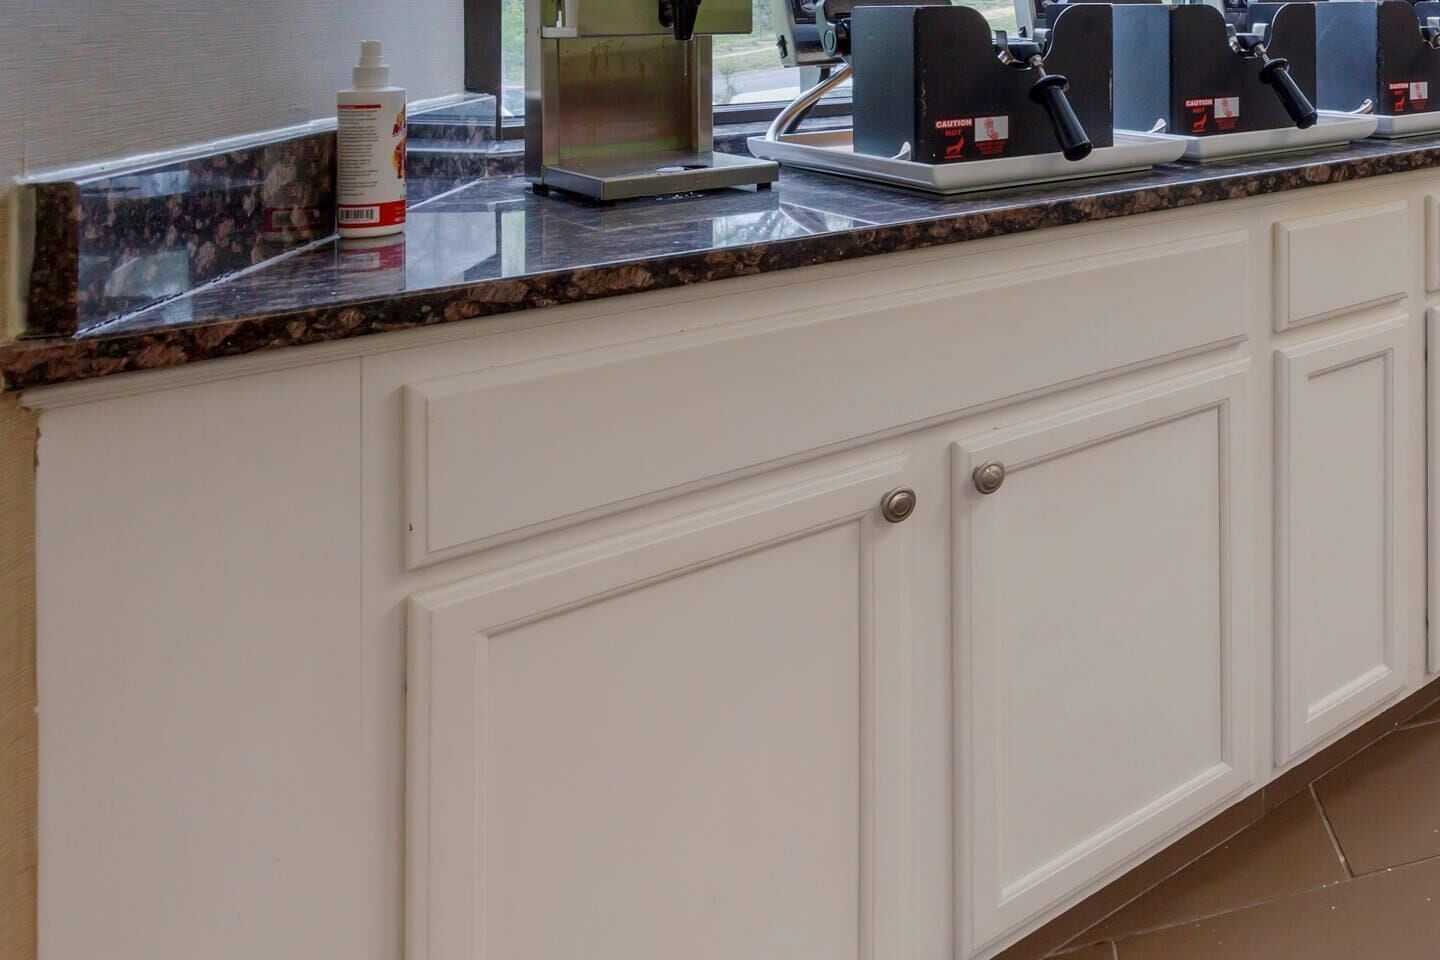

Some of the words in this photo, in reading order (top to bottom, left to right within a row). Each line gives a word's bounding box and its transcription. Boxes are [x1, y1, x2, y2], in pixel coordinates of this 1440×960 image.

[1185, 98, 1213, 107] CAUTION
[935, 118, 973, 129] CAUTION
[945, 129, 962, 137] HOT
